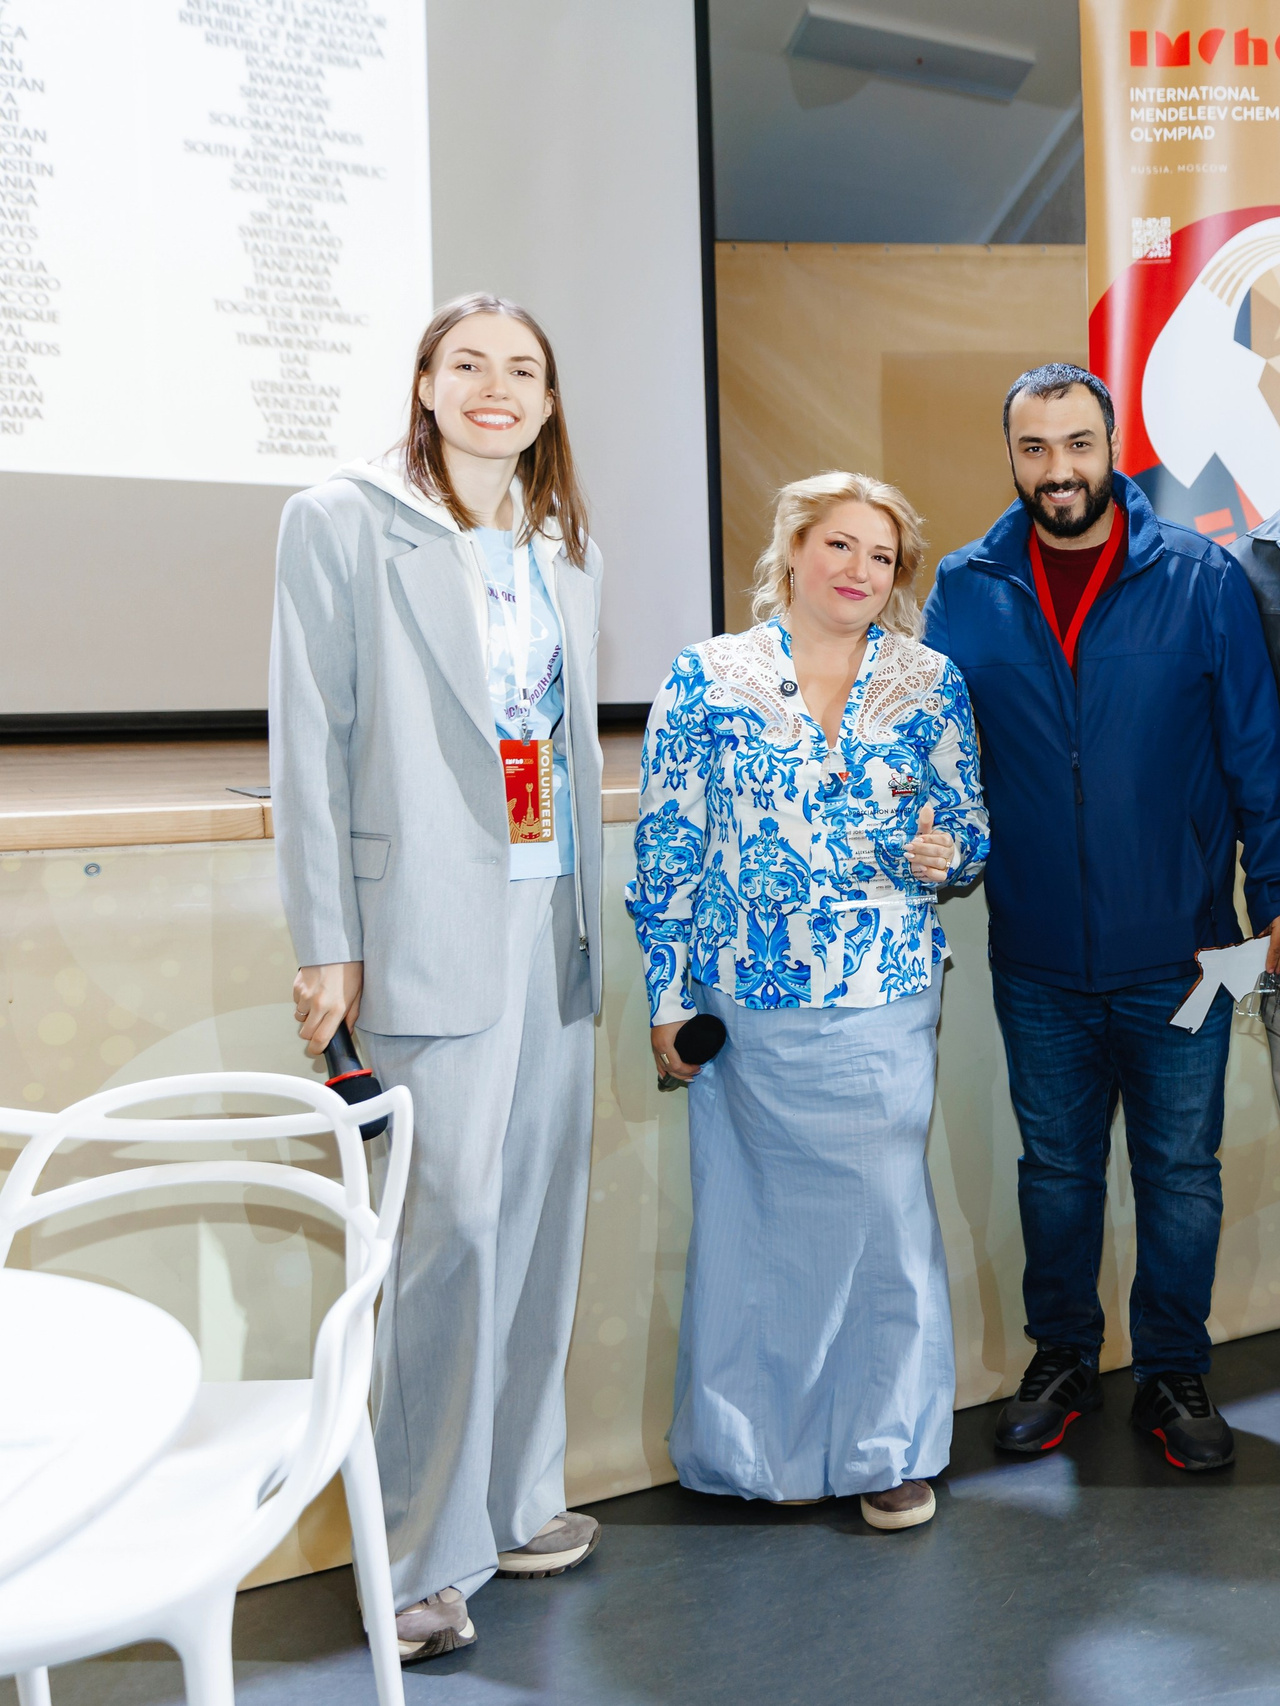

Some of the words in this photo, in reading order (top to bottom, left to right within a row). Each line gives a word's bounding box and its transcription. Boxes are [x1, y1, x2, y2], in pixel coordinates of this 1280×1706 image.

[179, 10, 251, 34] REPUBLIC
[259, 26, 278, 39] OF
[286, 31, 384, 59] NICARAGUA
[205, 31, 281, 55] REPUBLIC
[284, 46, 304, 59] OF
[245, 54, 325, 79] ROMANIA
[250, 70, 322, 94] RWANDA
[1129, 85, 1260, 102] INTERNATIONAL
[240, 84, 330, 111] SINGAPORE
[247, 102, 325, 125] SLOVENIA
[1130, 105, 1228, 123] MENDELEEV
[208, 111, 295, 136] SOLOMON
[301, 126, 364, 146] ISLANDS
[1130, 125, 1215, 142] OLYMPIAD
[251, 133, 325, 156] SOMALIA
[183, 138, 237, 159] SOUTH
[242, 147, 313, 169] AFRICAN
[318, 158, 388, 180] REPUBLIC
[1130, 164, 1174, 175] RUSSIA,
[1177, 163, 1228, 174] MOSCOW
[233, 161, 285, 181] SOUTH
[289, 169, 342, 189] KOREA
[229, 176, 281, 195] SOUTH
[286, 184, 348, 205] OSSETIA
[266, 197, 313, 215] SPAIN
[249, 210, 273, 224] SRI
[276, 213, 330, 232] LANKA
[238, 223, 343, 250] SWITZERLAND
[252, 254, 332, 278] TANZANIA
[253, 271, 331, 292] THAILAND
[243, 285, 267, 301] THE
[274, 289, 341, 309] GAMBIA
[213, 298, 294, 319] TOGOLESE
[300, 309, 369, 327] REPUBLIC
[266, 319, 321, 337] TURKEY
[235, 331, 351, 355] TURKMENISTAN
[279, 351, 309, 367] UAE
[279, 367, 311, 381] USA
[250, 379, 340, 399] UZBEKISTAN
[252, 394, 340, 414] VENEZUELA
[261, 410, 332, 428] VIETNAM
[267, 425, 328, 442] ZAMBIA
[256, 439, 339, 459] ZIMBABWE
[540, 744, 552, 838] VOLUNTEER
